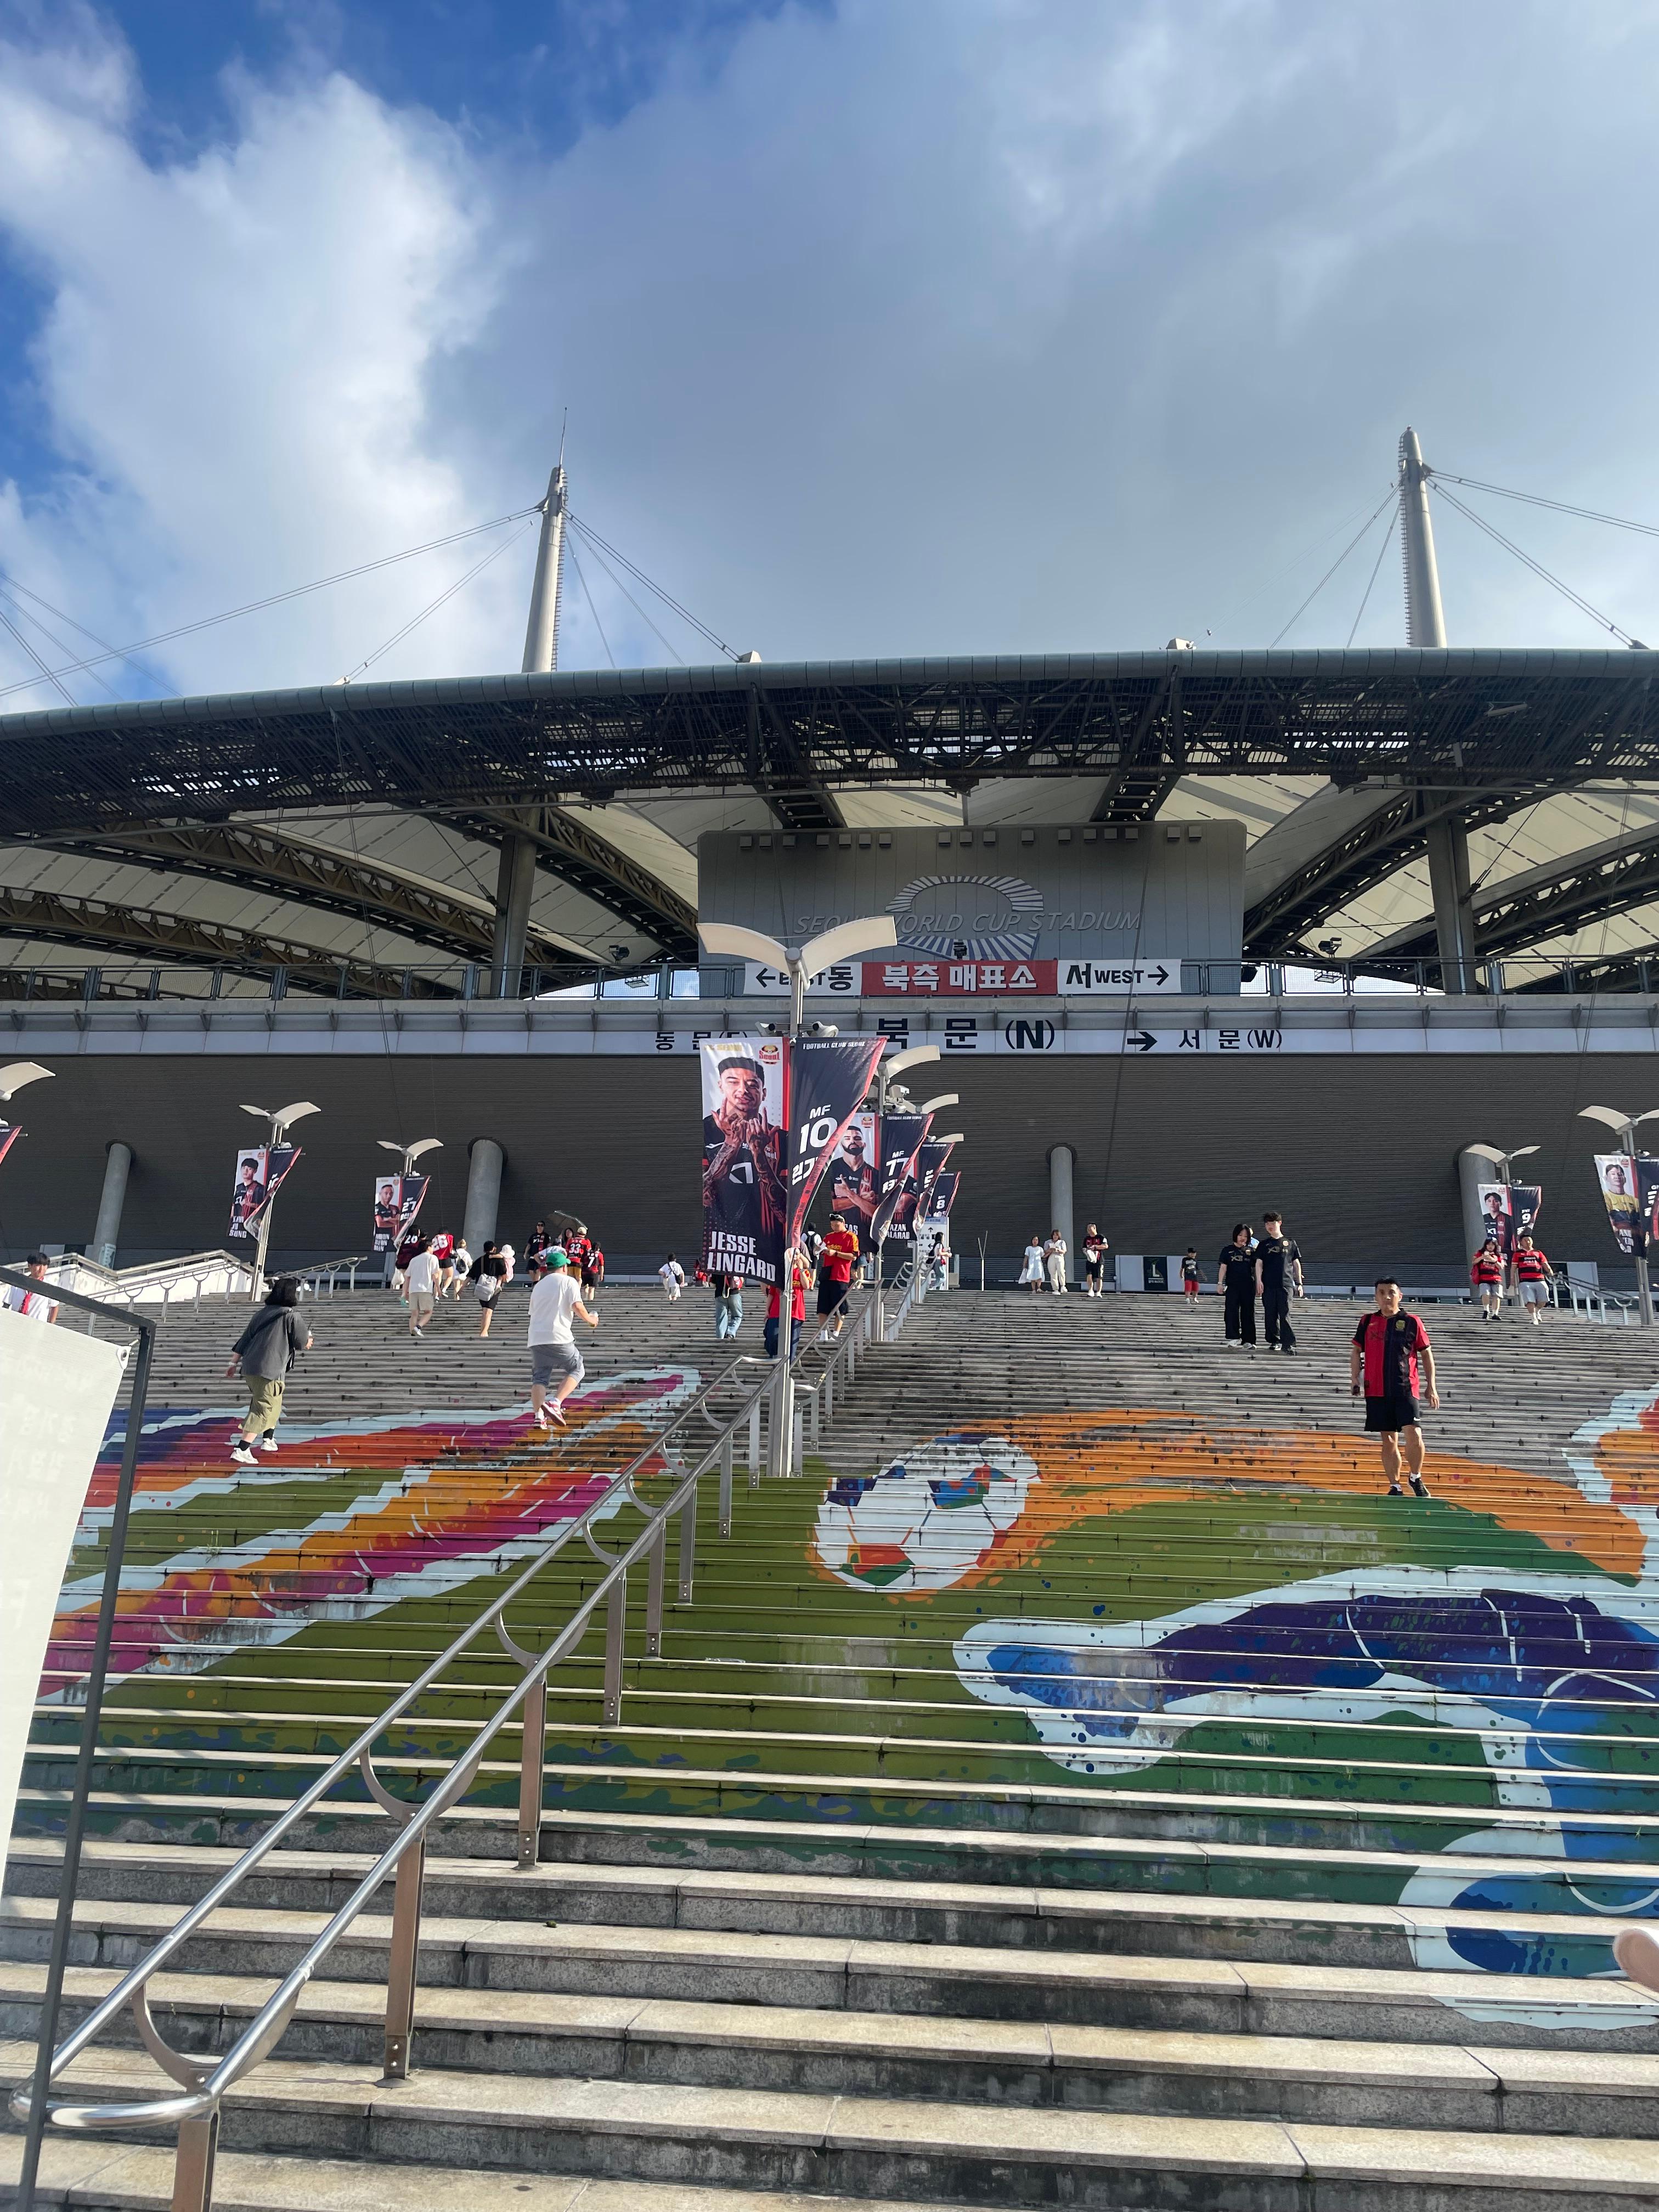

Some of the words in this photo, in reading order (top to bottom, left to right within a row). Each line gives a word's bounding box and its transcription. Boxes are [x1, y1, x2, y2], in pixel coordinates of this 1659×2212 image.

[794, 915, 866, 934] SEO
[972, 913, 1021, 932] CUP
[1028, 911, 1140, 931] STADIUM
[882, 964, 940, 991] 북측
[949, 964, 1037, 991] 매표소
[809, 1104, 831, 1119] MF
[799, 1117, 838, 1154] 10
[402, 1201, 417, 1213] 27
[936, 1199, 945, 1209] 8
[1521, 1213, 1531, 1224] 9
[708, 1231, 757, 1256] JESSE
[588, 1256, 595, 1267] 7
[707, 1251, 776, 1282] LINGARD
